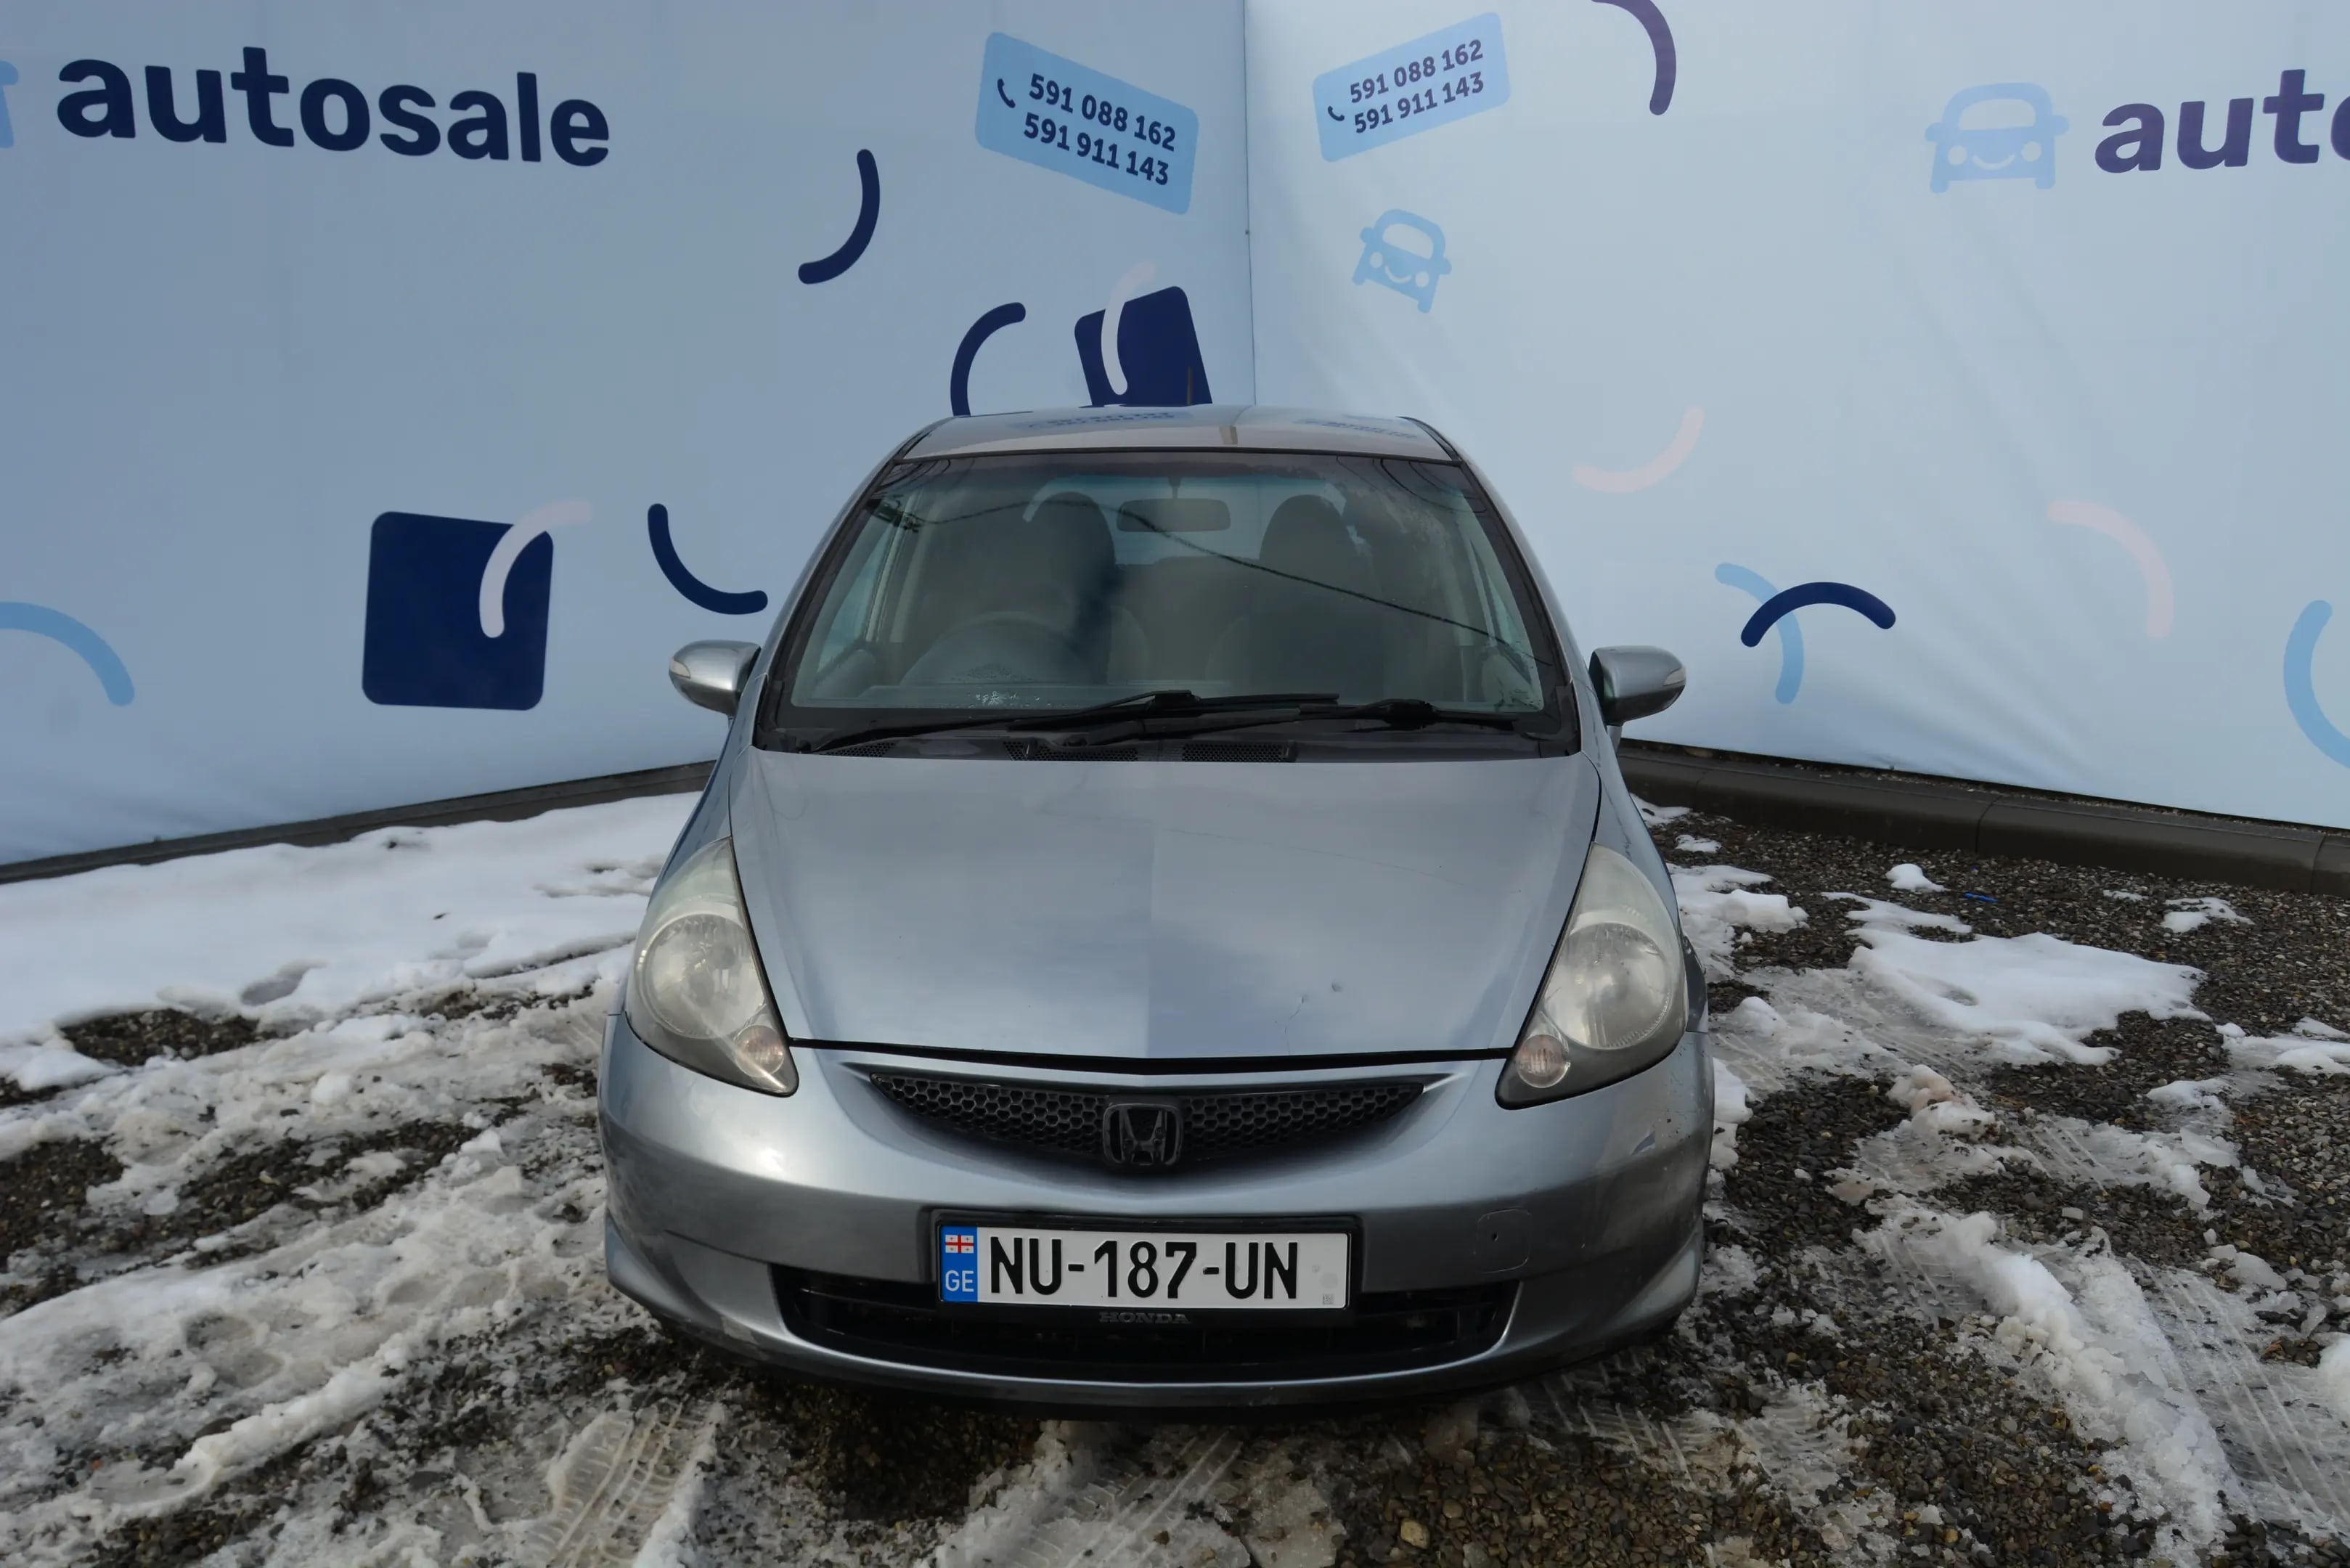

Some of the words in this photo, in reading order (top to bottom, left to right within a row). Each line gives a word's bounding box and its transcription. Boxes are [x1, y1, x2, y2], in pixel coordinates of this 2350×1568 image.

[1350, 73, 1389, 104] 591
[1394, 56, 1436, 87] 088
[1442, 39, 1483, 71] 162
[1354, 104, 1393, 134] 591
[1398, 89, 1437, 119] 911
[1442, 71, 1484, 104] 143
[57, 46, 609, 167] autosale
[1029, 73, 1074, 113] 591
[1081, 94, 1128, 132] 088
[1134, 115, 1176, 152] 162
[2094, 68, 2350, 173] aut
[1024, 112, 1070, 152] 591
[1077, 132, 1119, 169] 911
[1126, 150, 1169, 186] 143
[945, 1270, 974, 1292] GE
[990, 1236, 1298, 1299] NU-187-UN
[1098, 1312, 1191, 1324] HONDA
